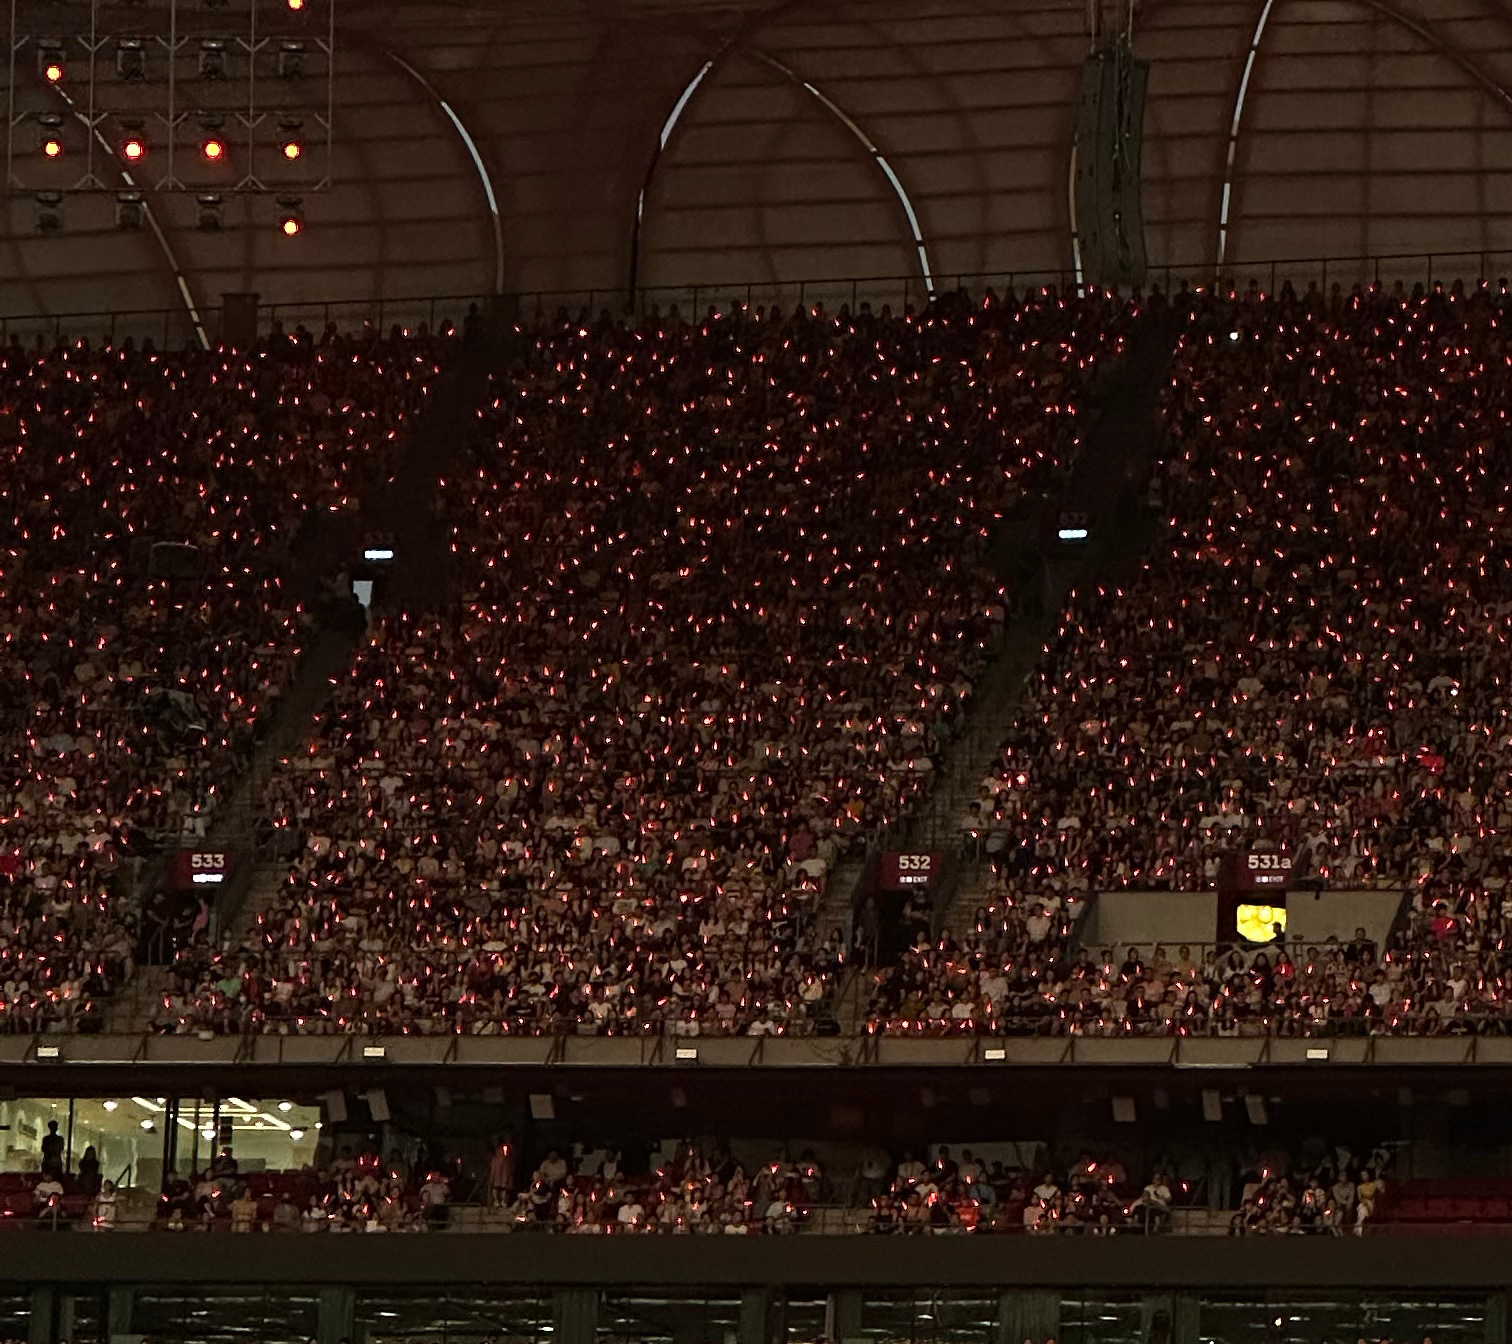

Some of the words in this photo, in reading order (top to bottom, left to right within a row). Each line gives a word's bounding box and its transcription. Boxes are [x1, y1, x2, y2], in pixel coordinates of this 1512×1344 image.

[191, 853, 225, 868] 533
[898, 855, 931, 869] 532
[1247, 854, 1292, 869] 531a
